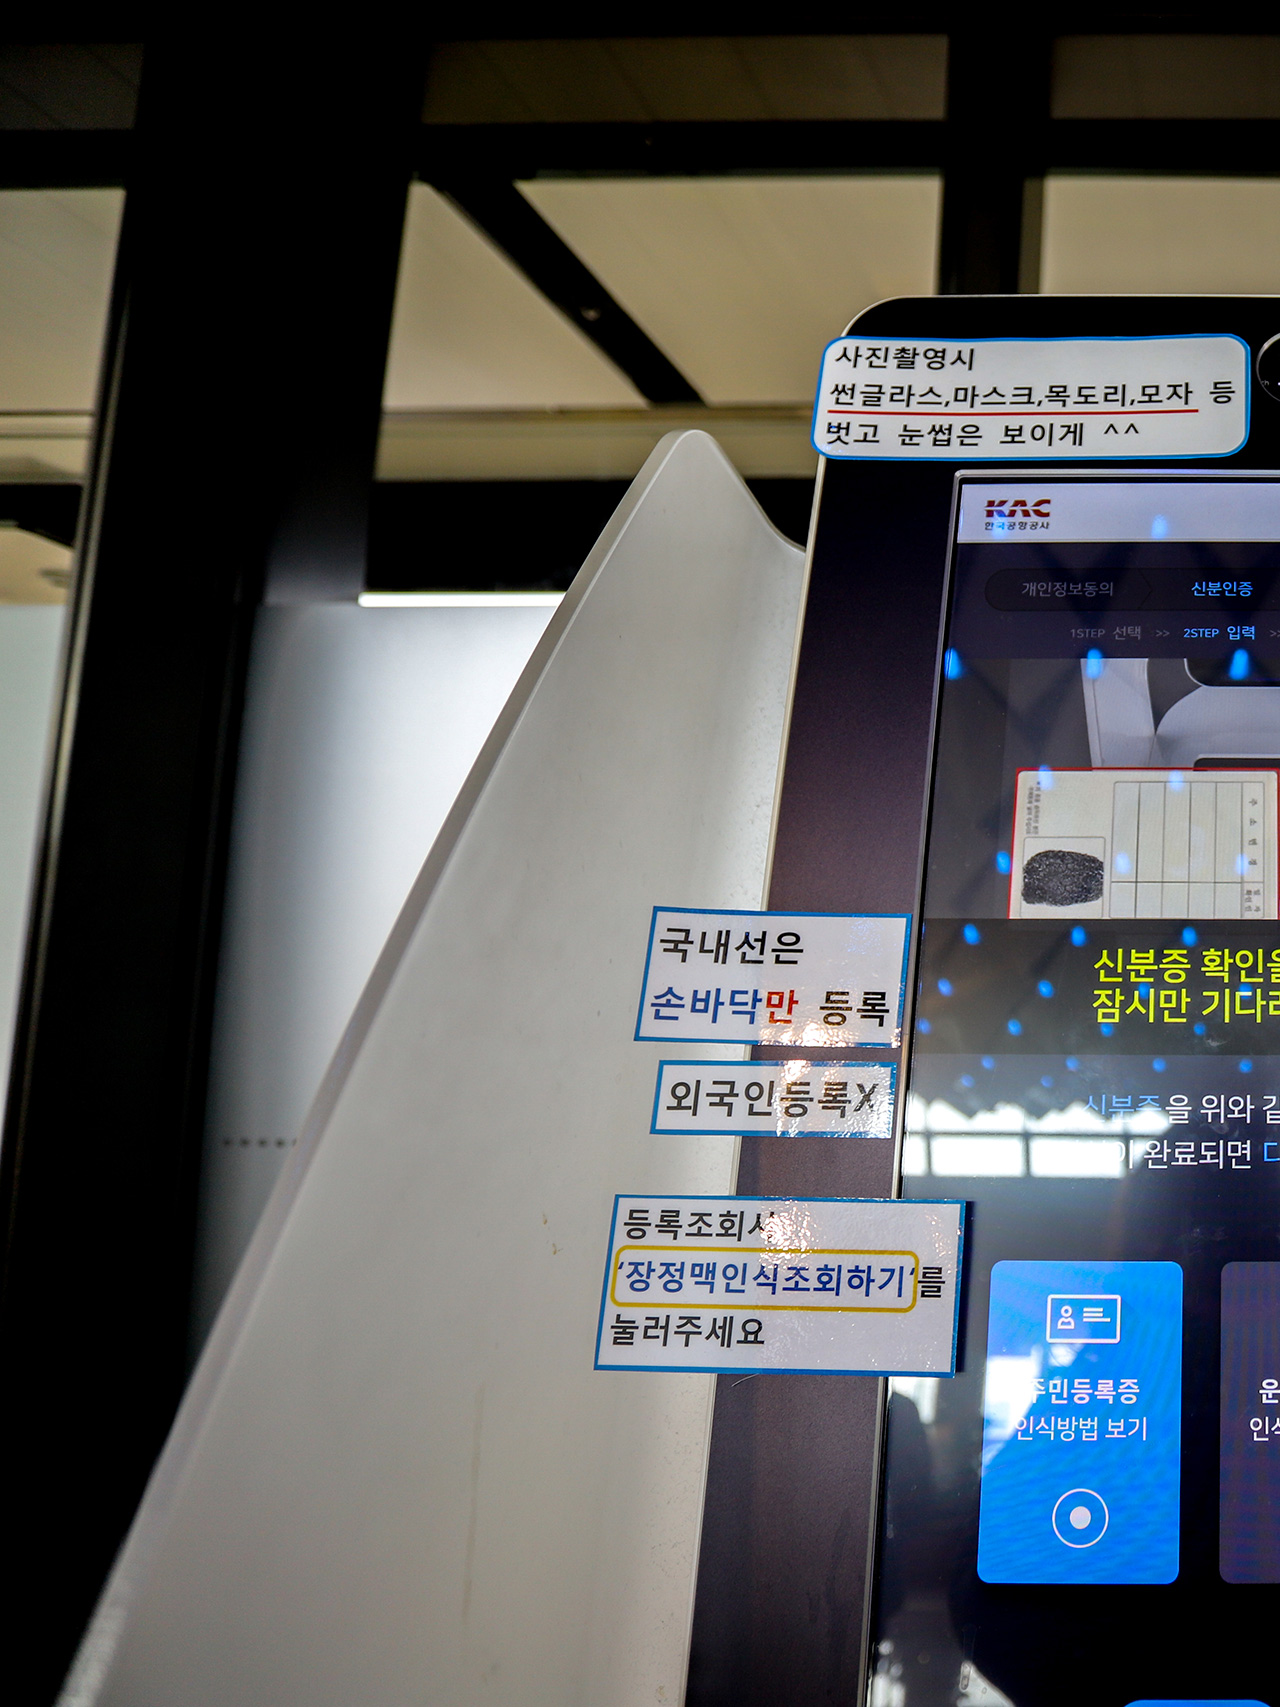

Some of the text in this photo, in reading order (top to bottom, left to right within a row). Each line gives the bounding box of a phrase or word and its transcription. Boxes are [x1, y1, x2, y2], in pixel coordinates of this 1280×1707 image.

[835, 345, 976, 371] 사진촬영시
[829, 380, 1237, 408] 썬글라스,마스크,목도리,모자 등
[826, 421, 880, 446] 벗고
[898, 422, 983, 447] 눈썹은
[999, 421, 1085, 447] 보이게
[985, 499, 1051, 518] KAC
[984, 521, 1050, 531] 한국공항공사
[1021, 581, 1114, 598] 개인정보동의
[1191, 581, 1254, 598] 신분인증
[1070, 625, 1142, 641] 1STEP 선택
[1183, 625, 1256, 641] 2STEP 입력
[659, 927, 804, 965] 국내선은
[1093, 948, 1191, 983] 신분증
[650, 986, 890, 1028] 손바닥만 등록
[1092, 988, 1190, 1023] 잠시만
[666, 1079, 879, 1119] 외국인등록X
[1200, 1094, 1255, 1124] 위와
[1143, 1139, 1251, 1169] 완료되면
[610, 1313, 765, 1348] 눌러주세요
[1015, 1416, 1148, 1442] 인식방법 보기
